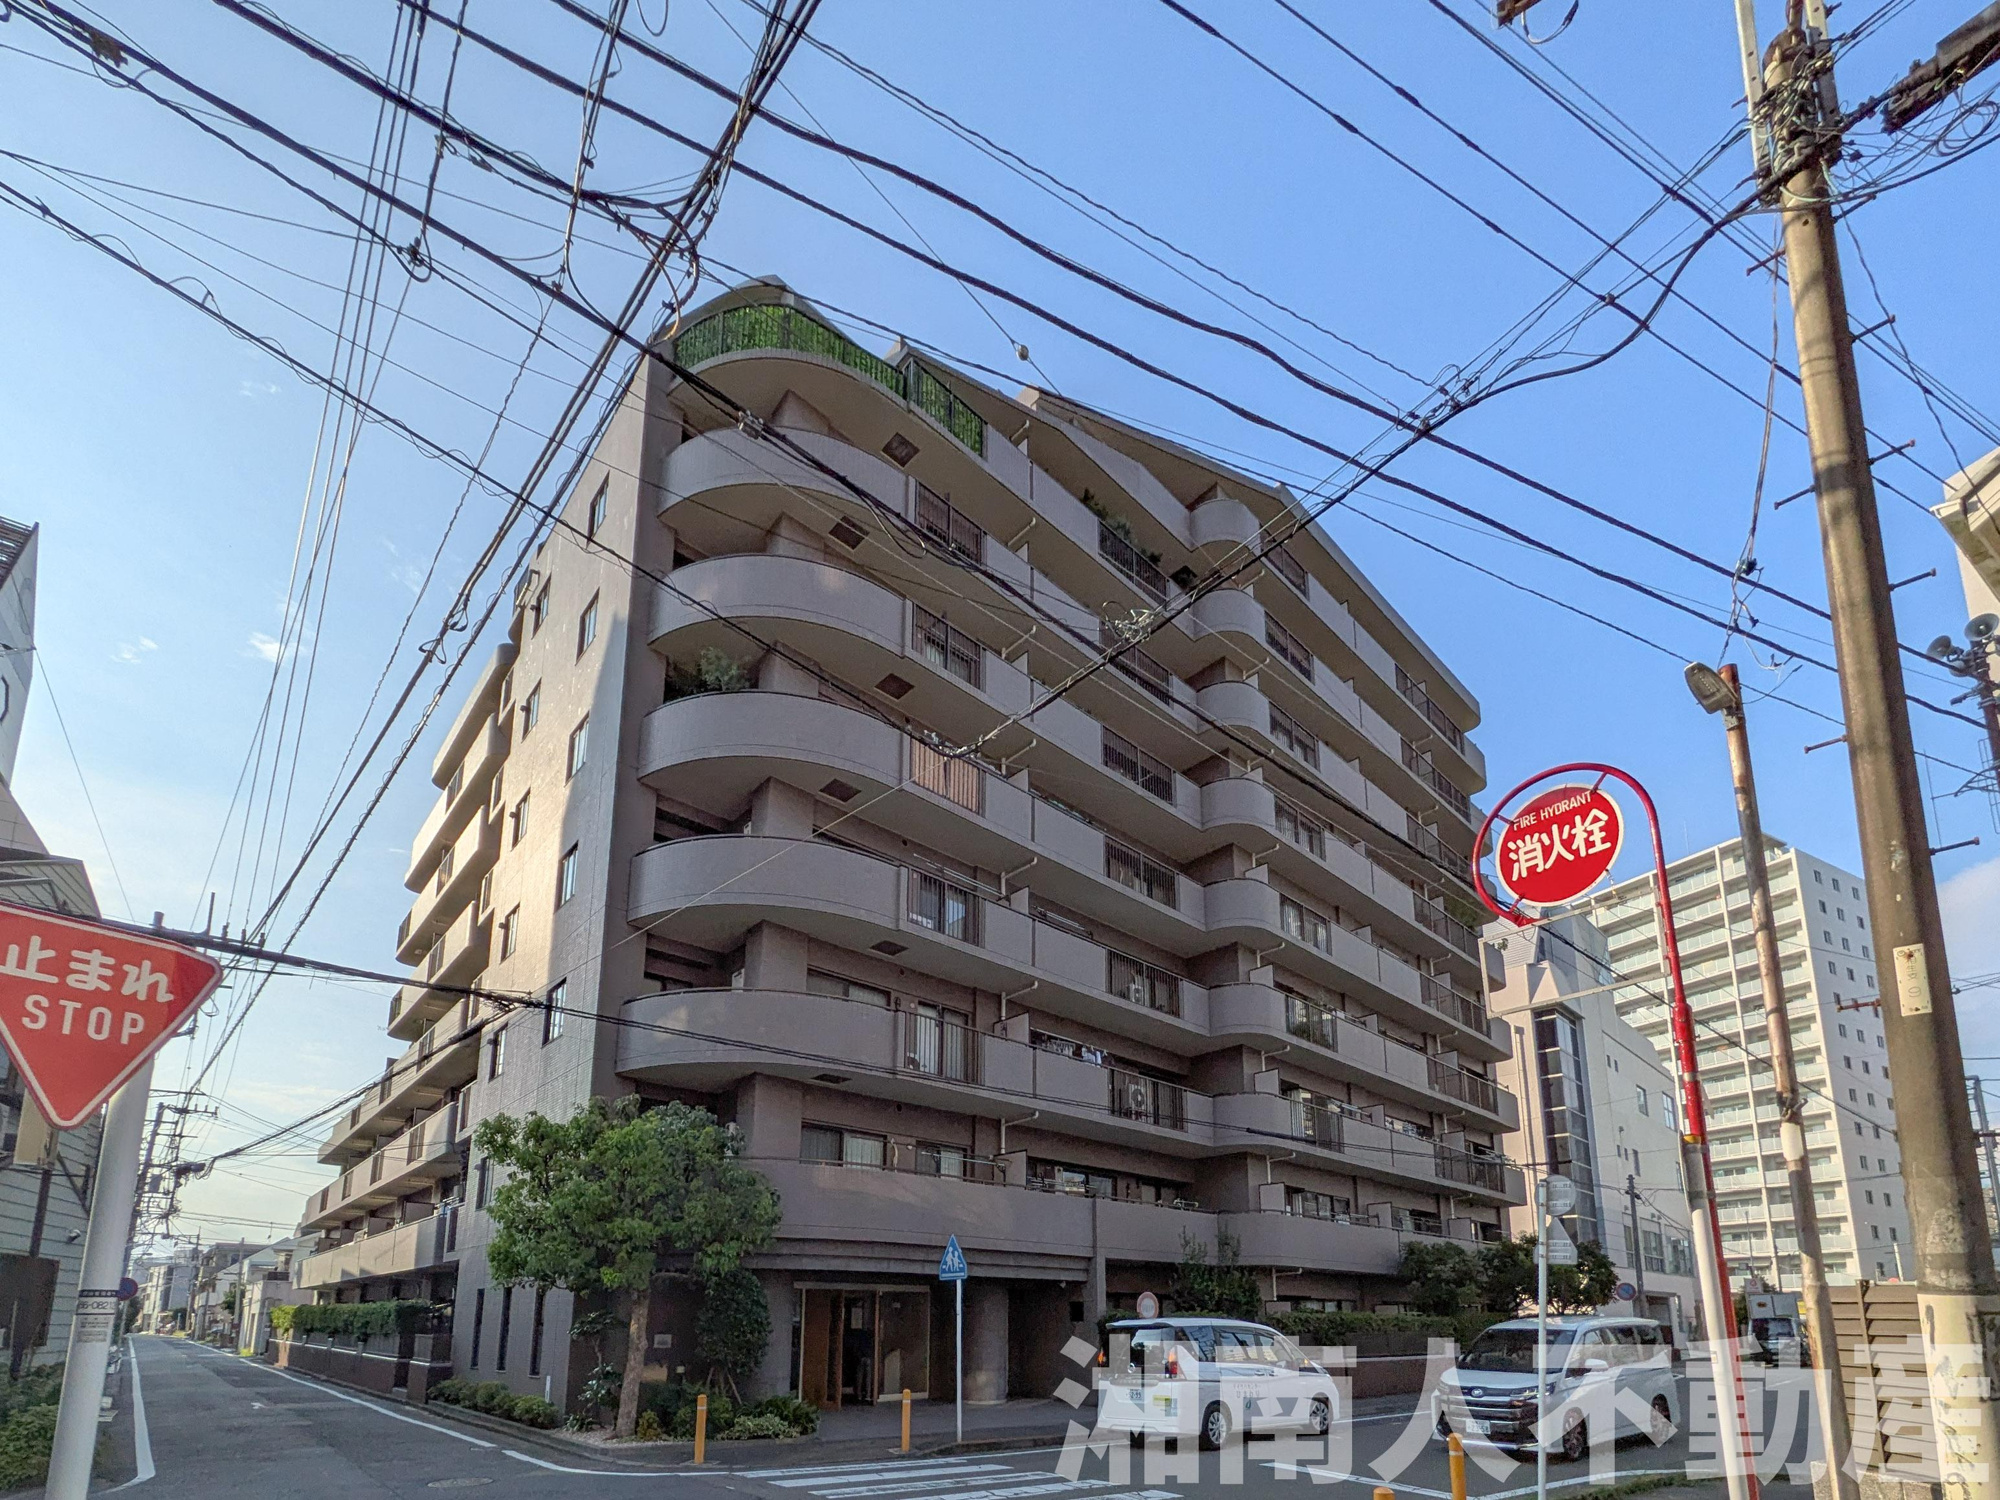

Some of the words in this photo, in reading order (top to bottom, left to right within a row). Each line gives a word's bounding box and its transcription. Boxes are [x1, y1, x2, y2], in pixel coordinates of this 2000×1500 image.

[1513, 812, 1537, 831] FIRE
[1540, 790, 1593, 820] HYDRANT
[1507, 807, 1612, 882] 消火栓
[0, 935, 175, 1003] 止まれ
[22, 994, 146, 1045] STOP
